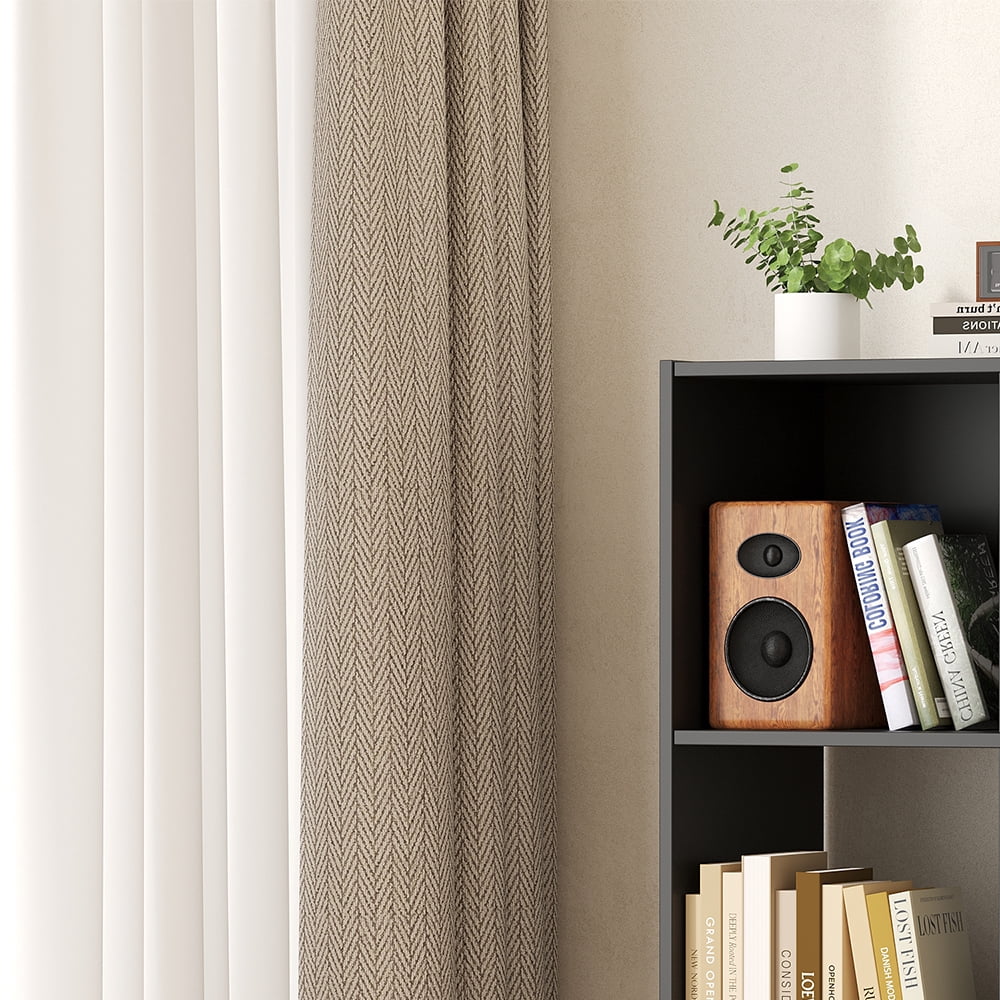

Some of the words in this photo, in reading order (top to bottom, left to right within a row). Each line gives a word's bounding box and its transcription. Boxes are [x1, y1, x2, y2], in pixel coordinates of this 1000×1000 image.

[893, 899, 912, 944] LOST
[917, 911, 944, 937] LOST
[943, 911, 964, 934] FISH
[705, 916, 716, 964] GRAND
[728, 942, 737, 967] Rooted
[690, 949, 698, 968] NEW
[880, 947, 891, 980] DANISH
[900, 948, 919, 990] FISH
[728, 978, 737, 993] THE
